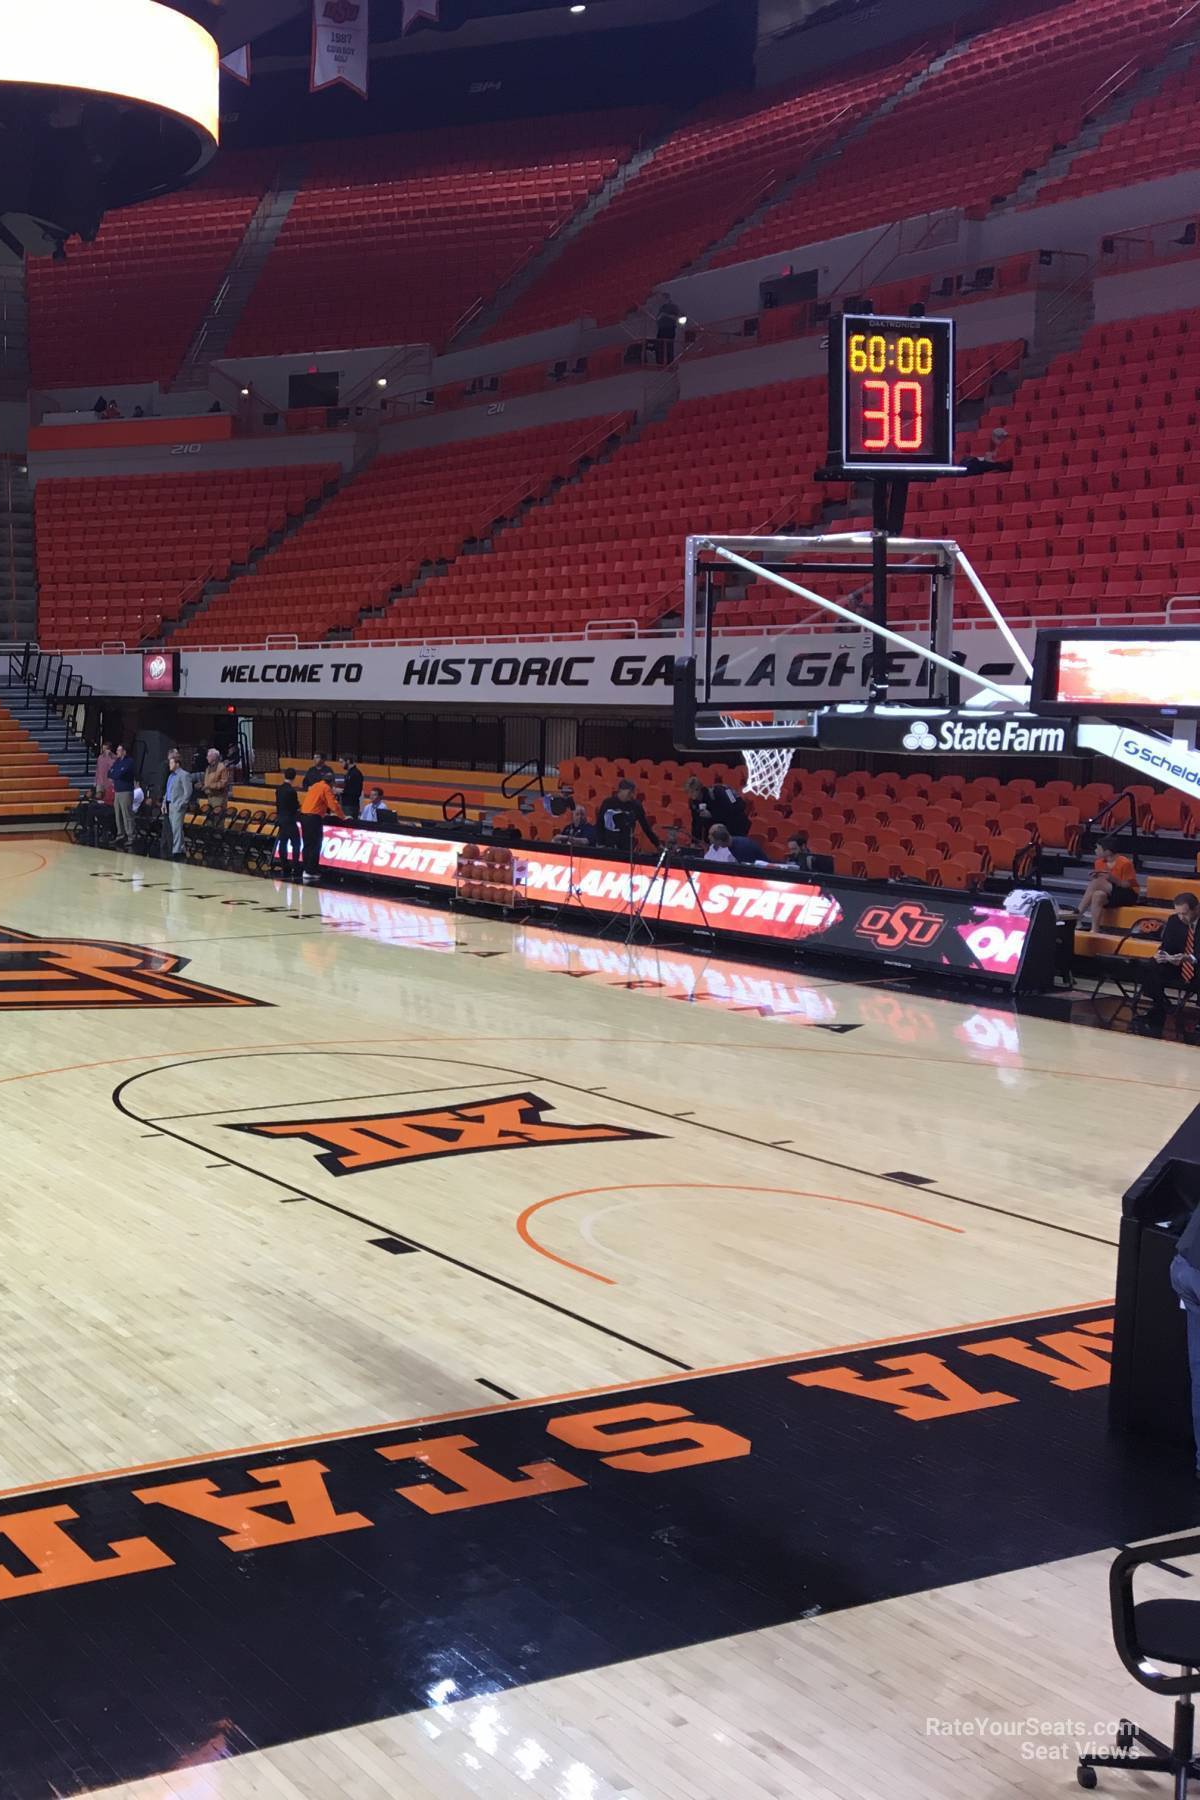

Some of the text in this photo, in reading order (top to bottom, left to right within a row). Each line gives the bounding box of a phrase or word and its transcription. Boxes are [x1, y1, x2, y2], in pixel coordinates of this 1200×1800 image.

[850, 335, 932, 374] 60:00
[863, 380, 922, 449] 30
[170, 443, 201, 455] 210
[220, 664, 324, 683] WELCOME
[330, 664, 363, 683] TO
[402, 657, 595, 686] HISTORIC
[374, 843, 452, 876] STATE
[520, 861, 699, 909] OKLAHOMA
[855, 900, 946, 949] OSU
